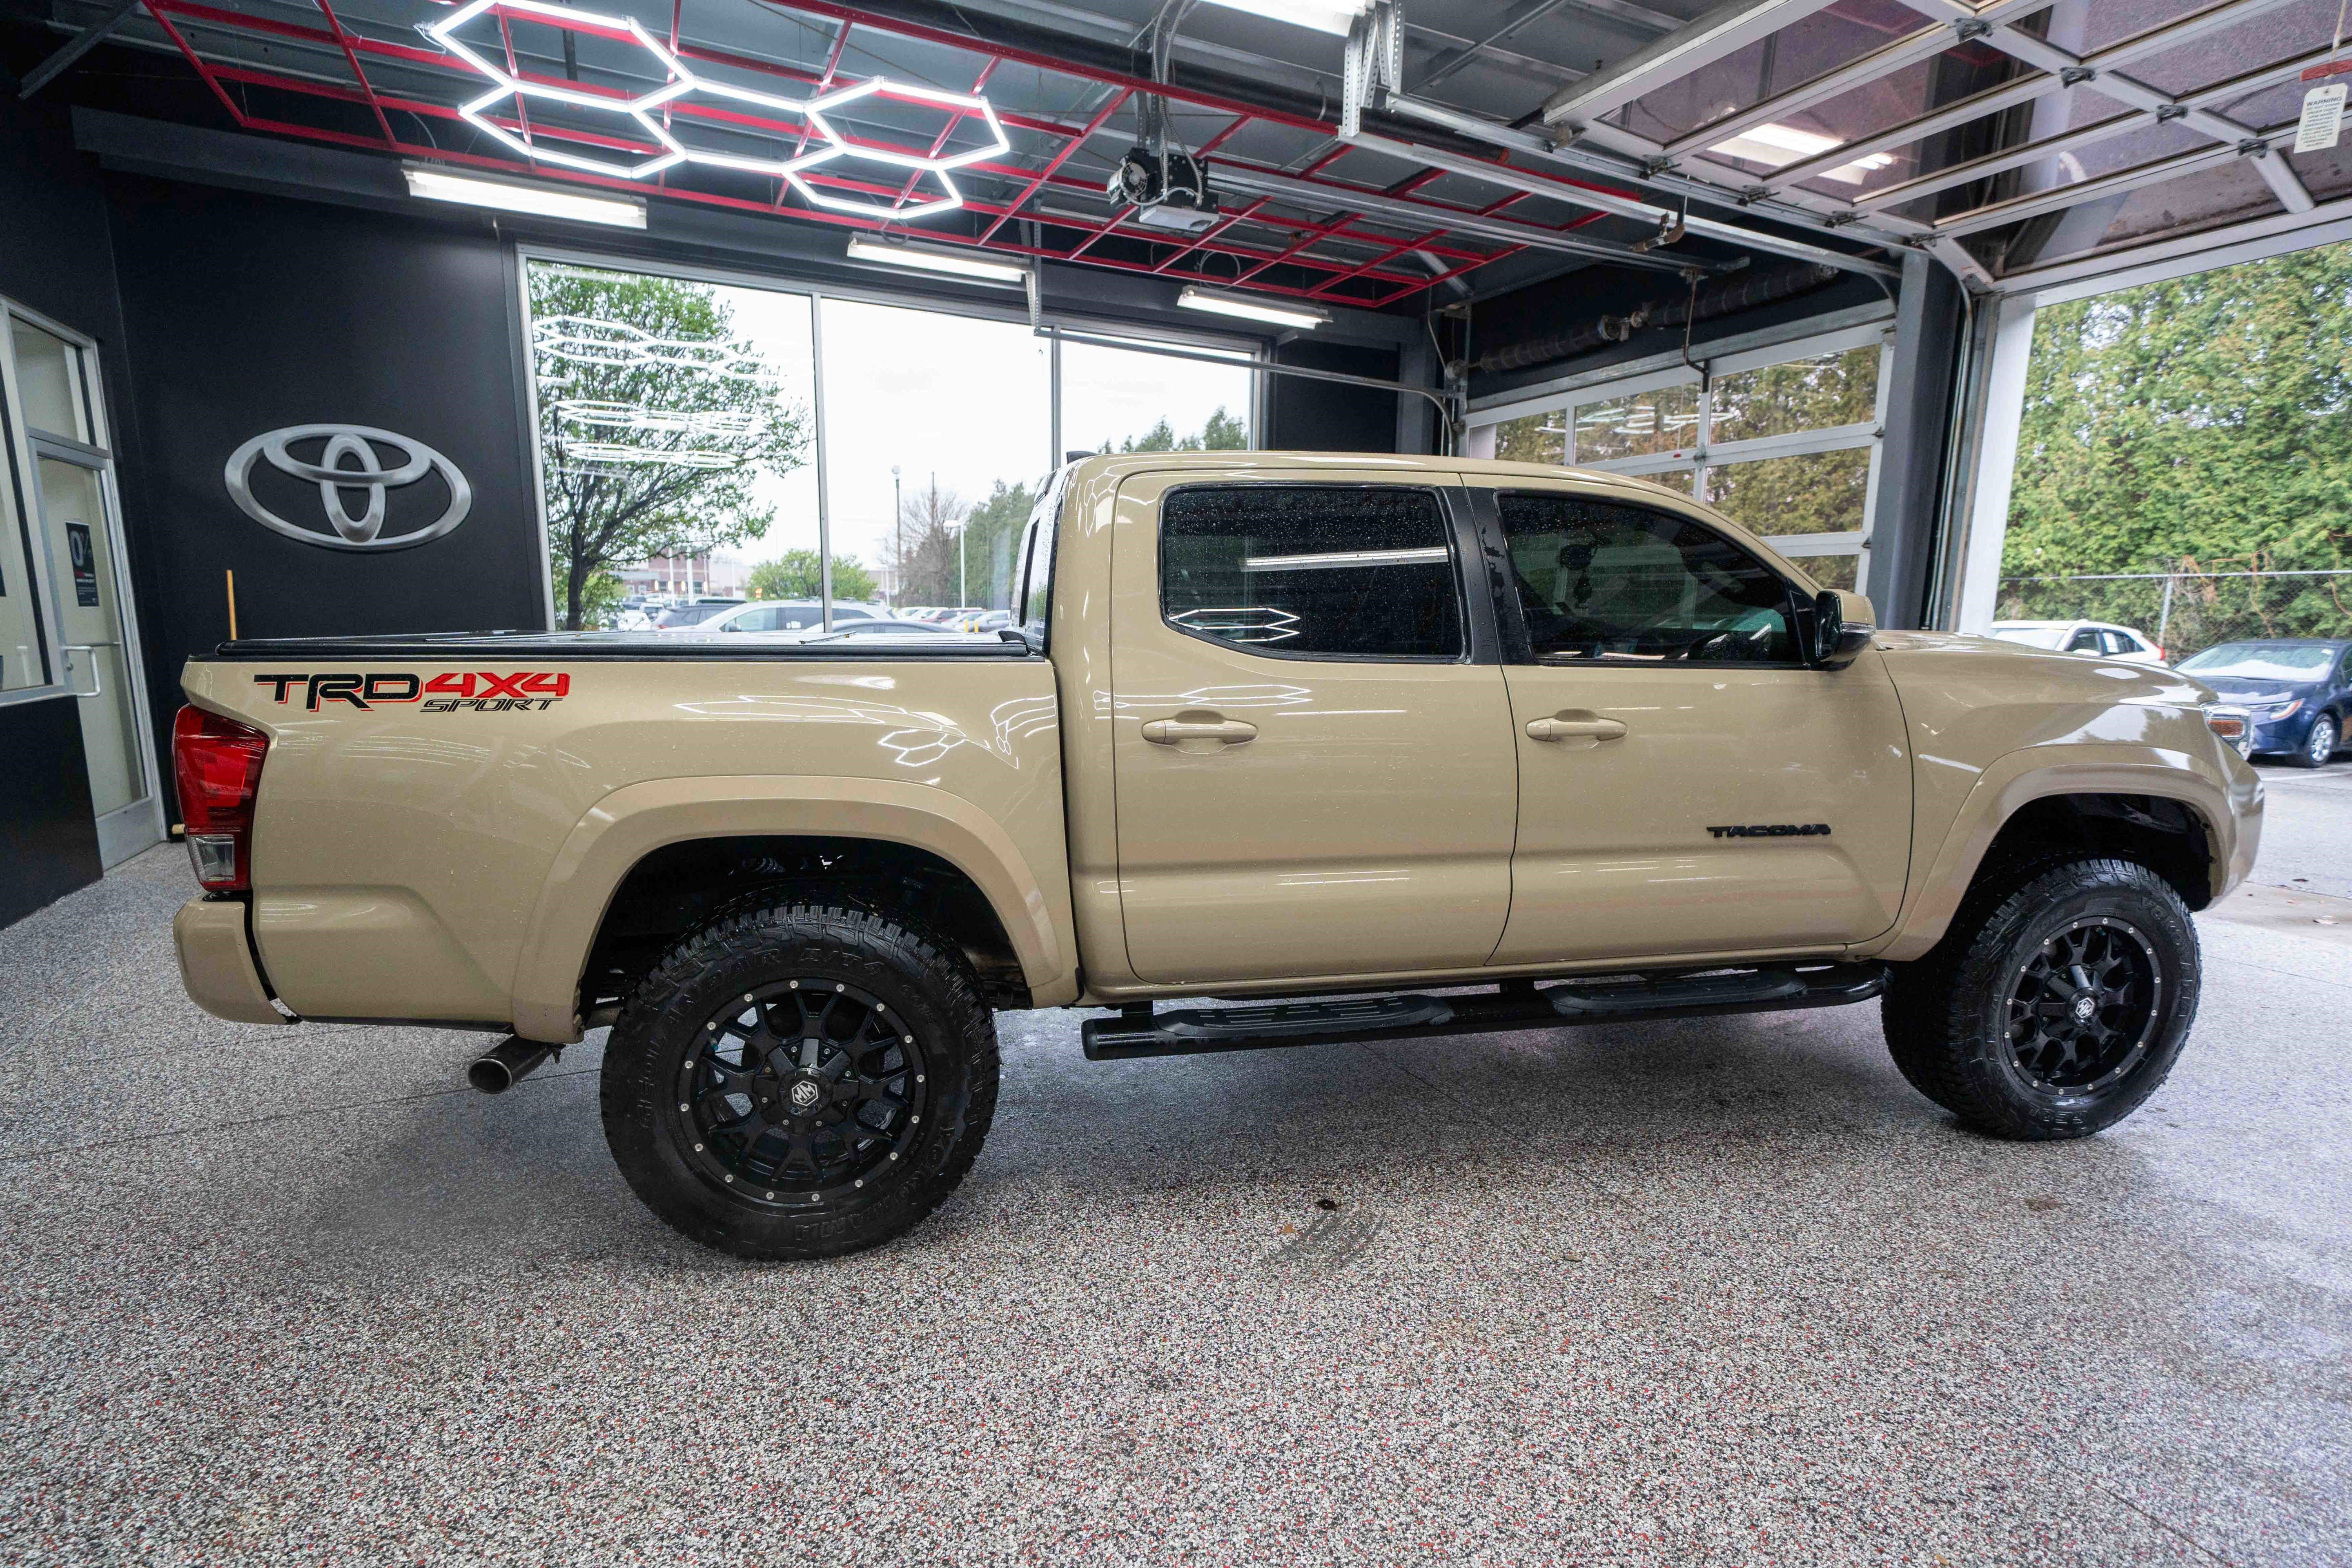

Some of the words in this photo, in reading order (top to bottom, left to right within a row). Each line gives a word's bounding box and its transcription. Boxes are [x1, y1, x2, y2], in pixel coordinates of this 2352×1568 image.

[2307, 96, 2342, 106] WARNING
[254, 674, 423, 712] TRD
[425, 673, 570, 698] 4X4
[420, 698, 563, 713] SPORT
[1706, 824, 1831, 838] TACOMA
